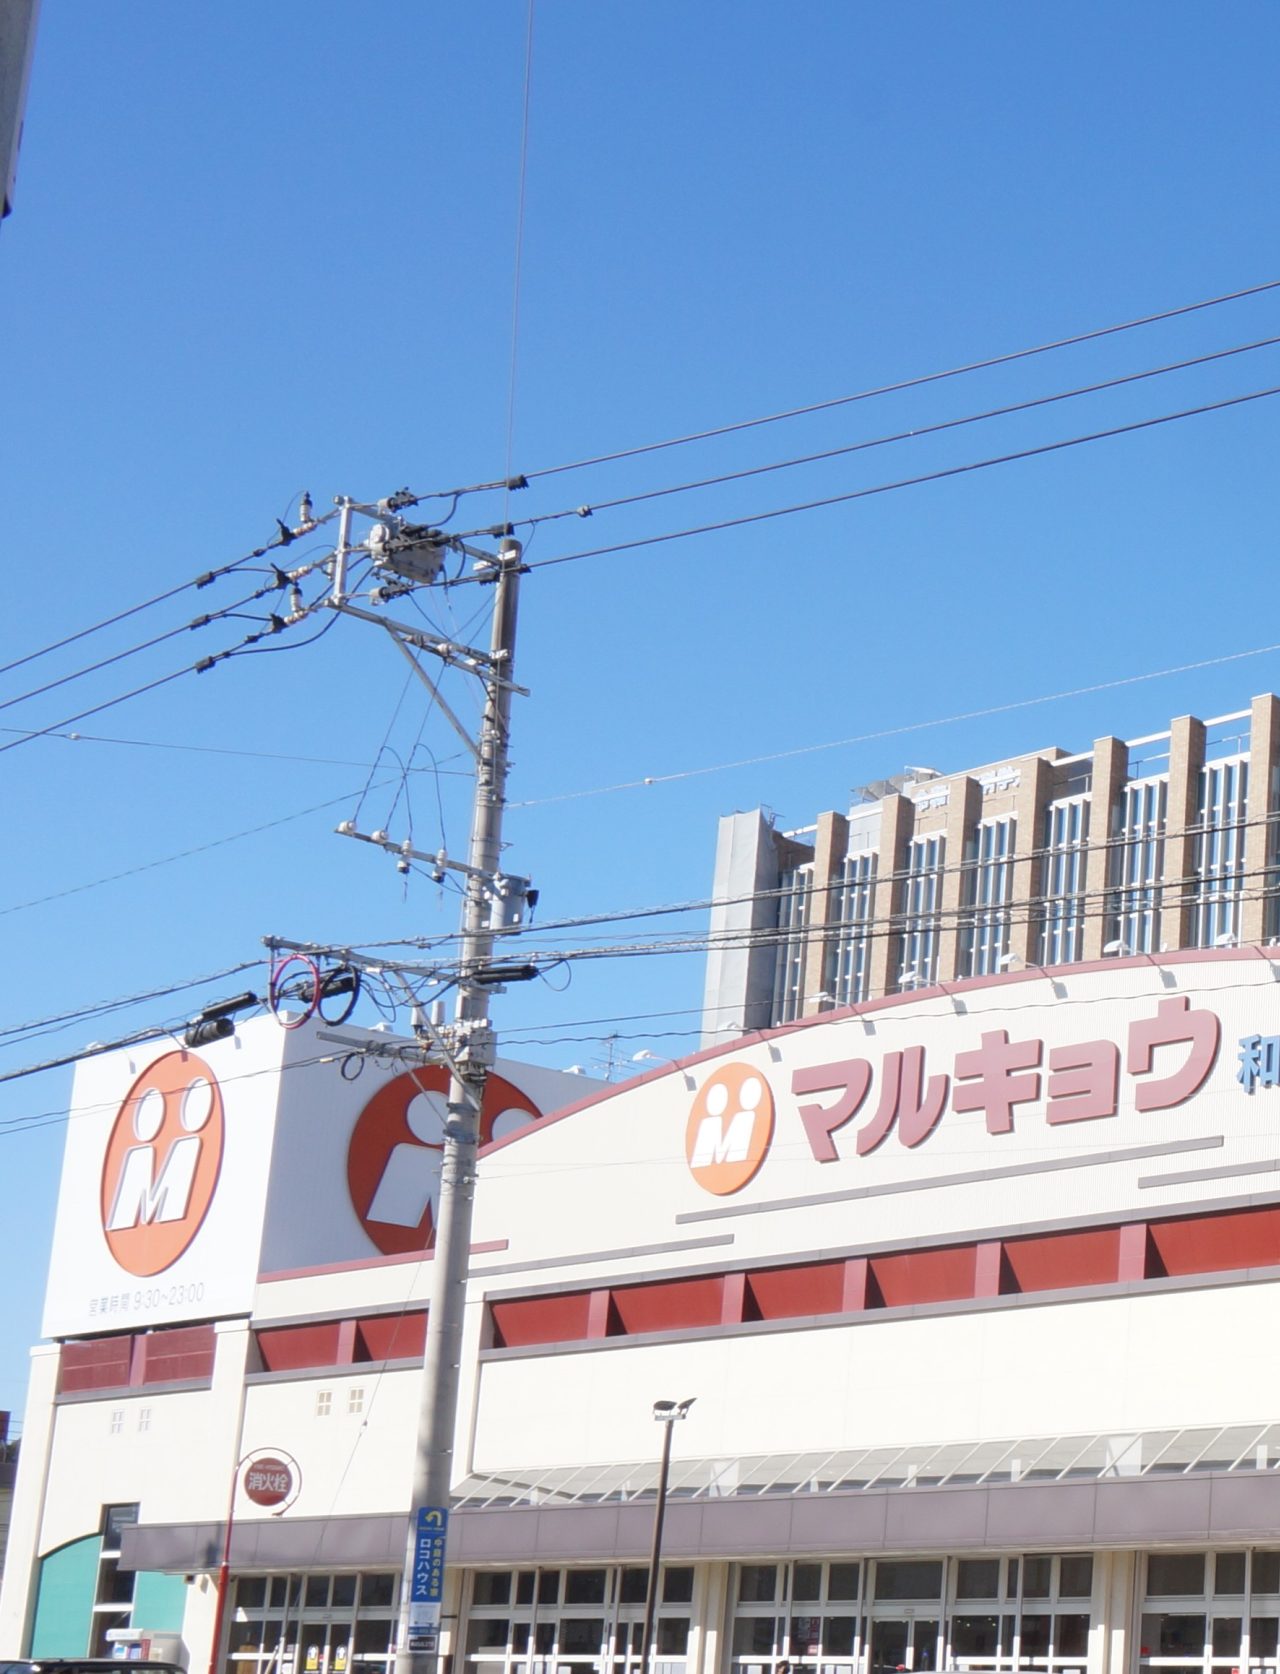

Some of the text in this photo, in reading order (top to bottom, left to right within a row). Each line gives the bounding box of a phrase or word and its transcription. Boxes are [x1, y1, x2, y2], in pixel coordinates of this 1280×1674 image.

[791, 996, 1220, 1163] マルキョウ
[248, 1472, 288, 1492] 消火栓
[416, 1538, 431, 1596] ロコハウス
